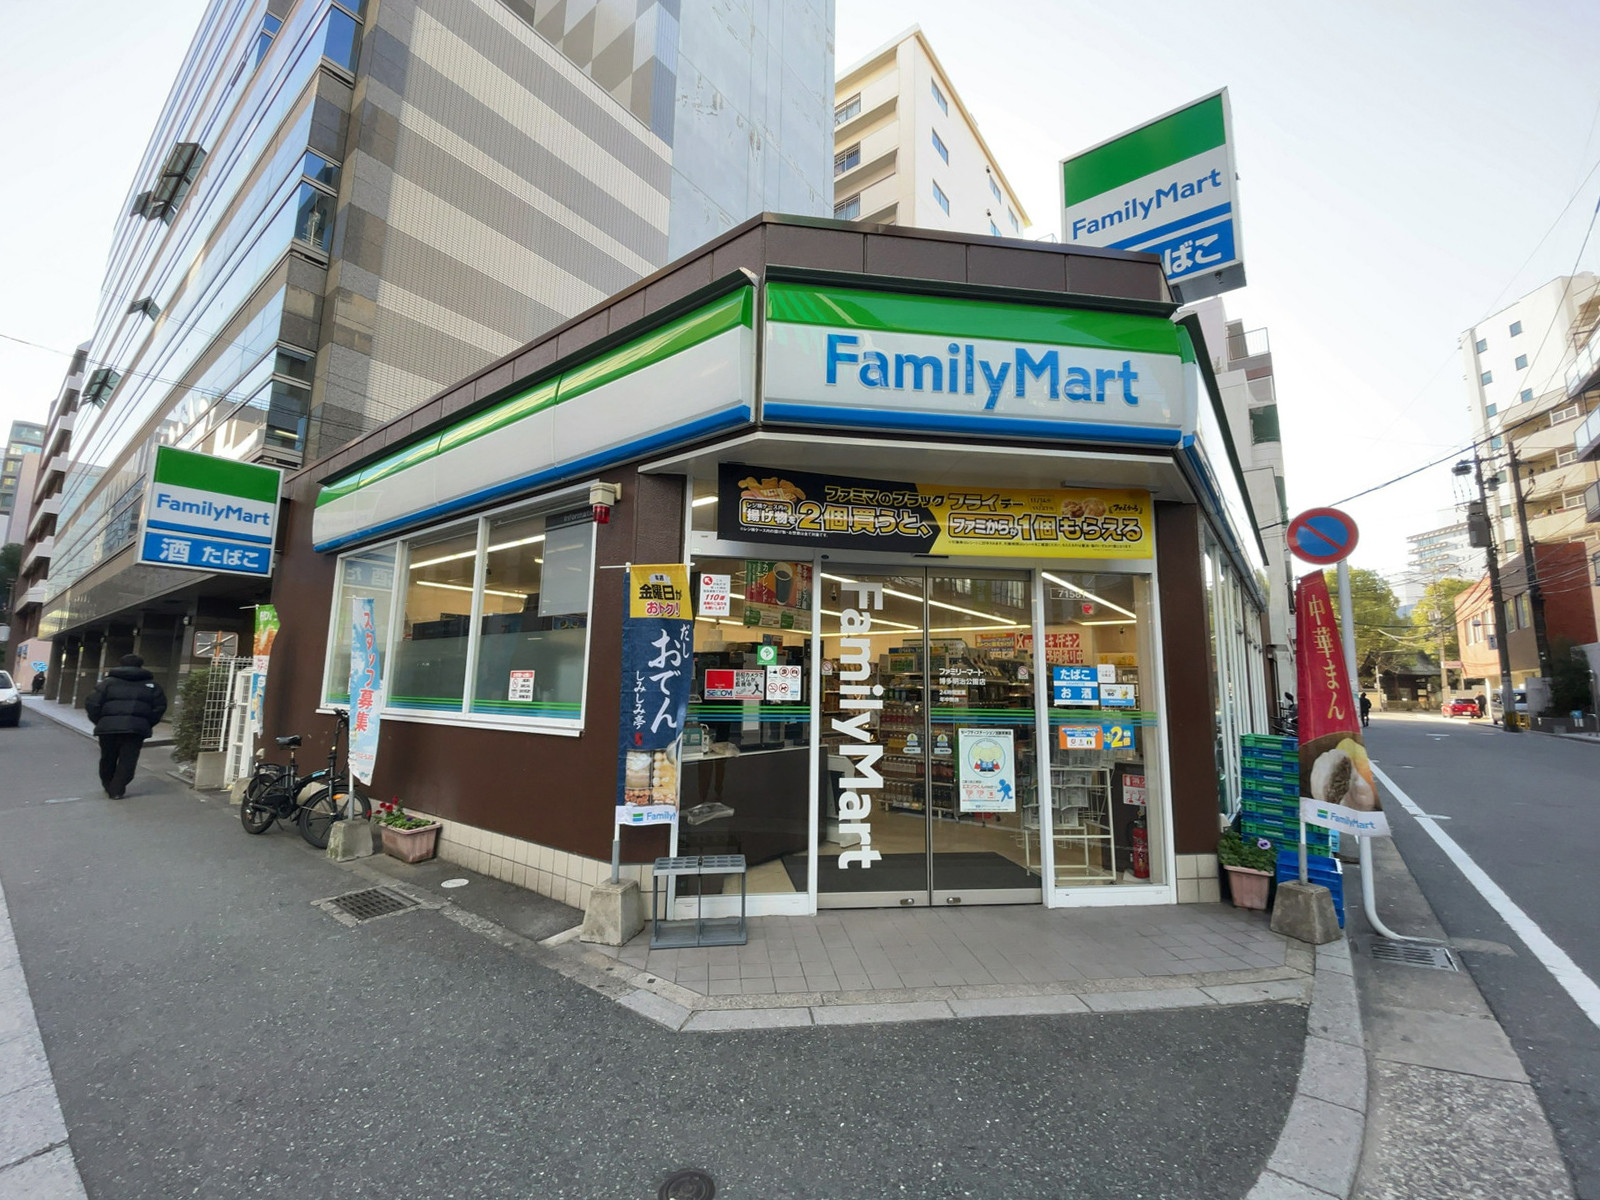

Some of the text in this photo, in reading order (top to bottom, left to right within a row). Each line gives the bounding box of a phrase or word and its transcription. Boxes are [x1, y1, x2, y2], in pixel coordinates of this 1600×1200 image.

[1072, 168, 1222, 240] FamilyMart
[1163, 233, 1222, 276] ばこ
[825, 333, 1140, 411] FamilyMart
[156, 493, 270, 527] FamilyMart
[746, 508, 796, 526] 揚げ物を
[159, 537, 260, 569] 酒 たばこ
[638, 583, 683, 601] 金曜日が
[680, 623, 691, 659] だし
[1308, 594, 1346, 721] 中華まん
[355, 610, 383, 734] スタッフ募集
[647, 628, 683, 734] おでん
[938, 667, 984, 677] ファミリーマート
[938, 676, 986, 686] 博多明治公園店
[1060, 668, 1091, 681] たばこ
[632, 670, 647, 730] しみしみ亭
[706, 689, 733, 697] SECOM
[831, 582, 884, 870] FamilyMart
[1329, 812, 1376, 830] FamilyMart
